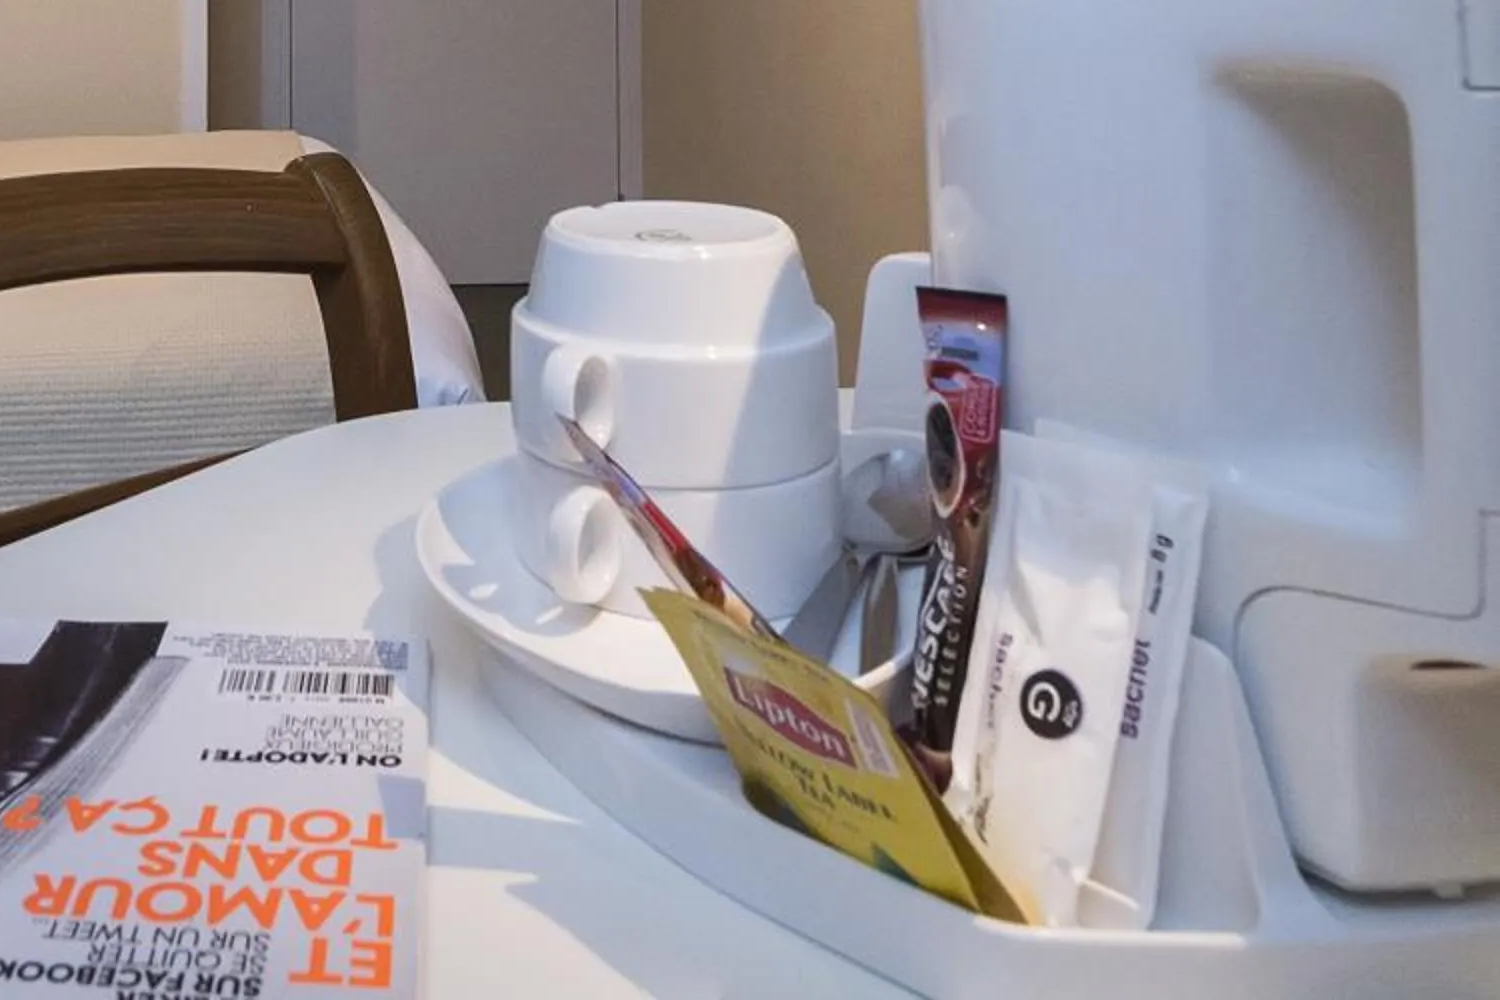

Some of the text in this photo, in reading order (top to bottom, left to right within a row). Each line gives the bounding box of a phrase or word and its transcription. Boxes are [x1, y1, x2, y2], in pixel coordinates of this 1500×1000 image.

[733, 674, 847, 758] Lipton
[356, 753, 402, 768] ON
[65, 797, 170, 834] ÇA
[180, 805, 399, 851] TOUT
[136, 841, 353, 887] DANS
[21, 874, 396, 938] L'AMOUR
[153, 924, 201, 946] UN
[210, 928, 271, 950] SUR
[86, 943, 268, 974] SE QUITTER
[287, 937, 393, 989] ET
[193, 973, 263, 997] SUR
